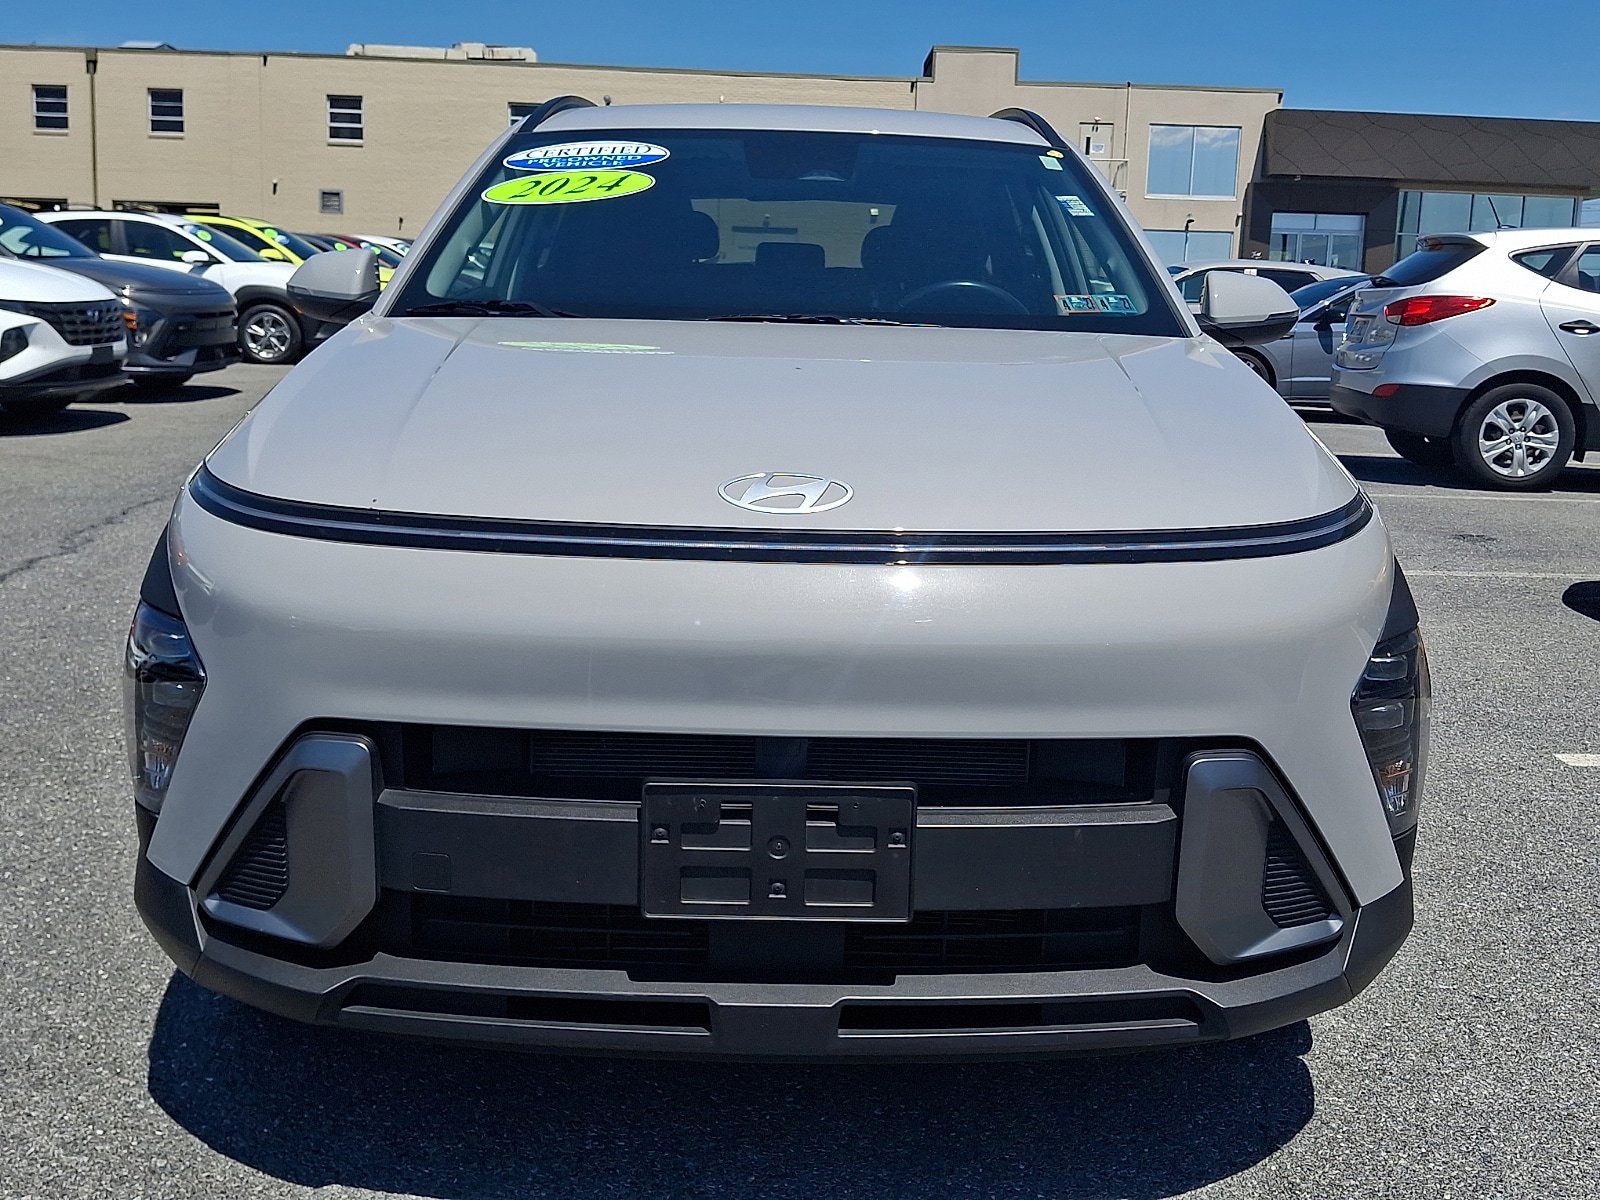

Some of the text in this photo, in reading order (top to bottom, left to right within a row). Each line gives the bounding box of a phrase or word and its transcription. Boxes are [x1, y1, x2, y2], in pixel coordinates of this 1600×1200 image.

[526, 145, 652, 158] CERTIFIED
[543, 160, 625, 168] VEHICLE
[508, 173, 632, 199] 2024
